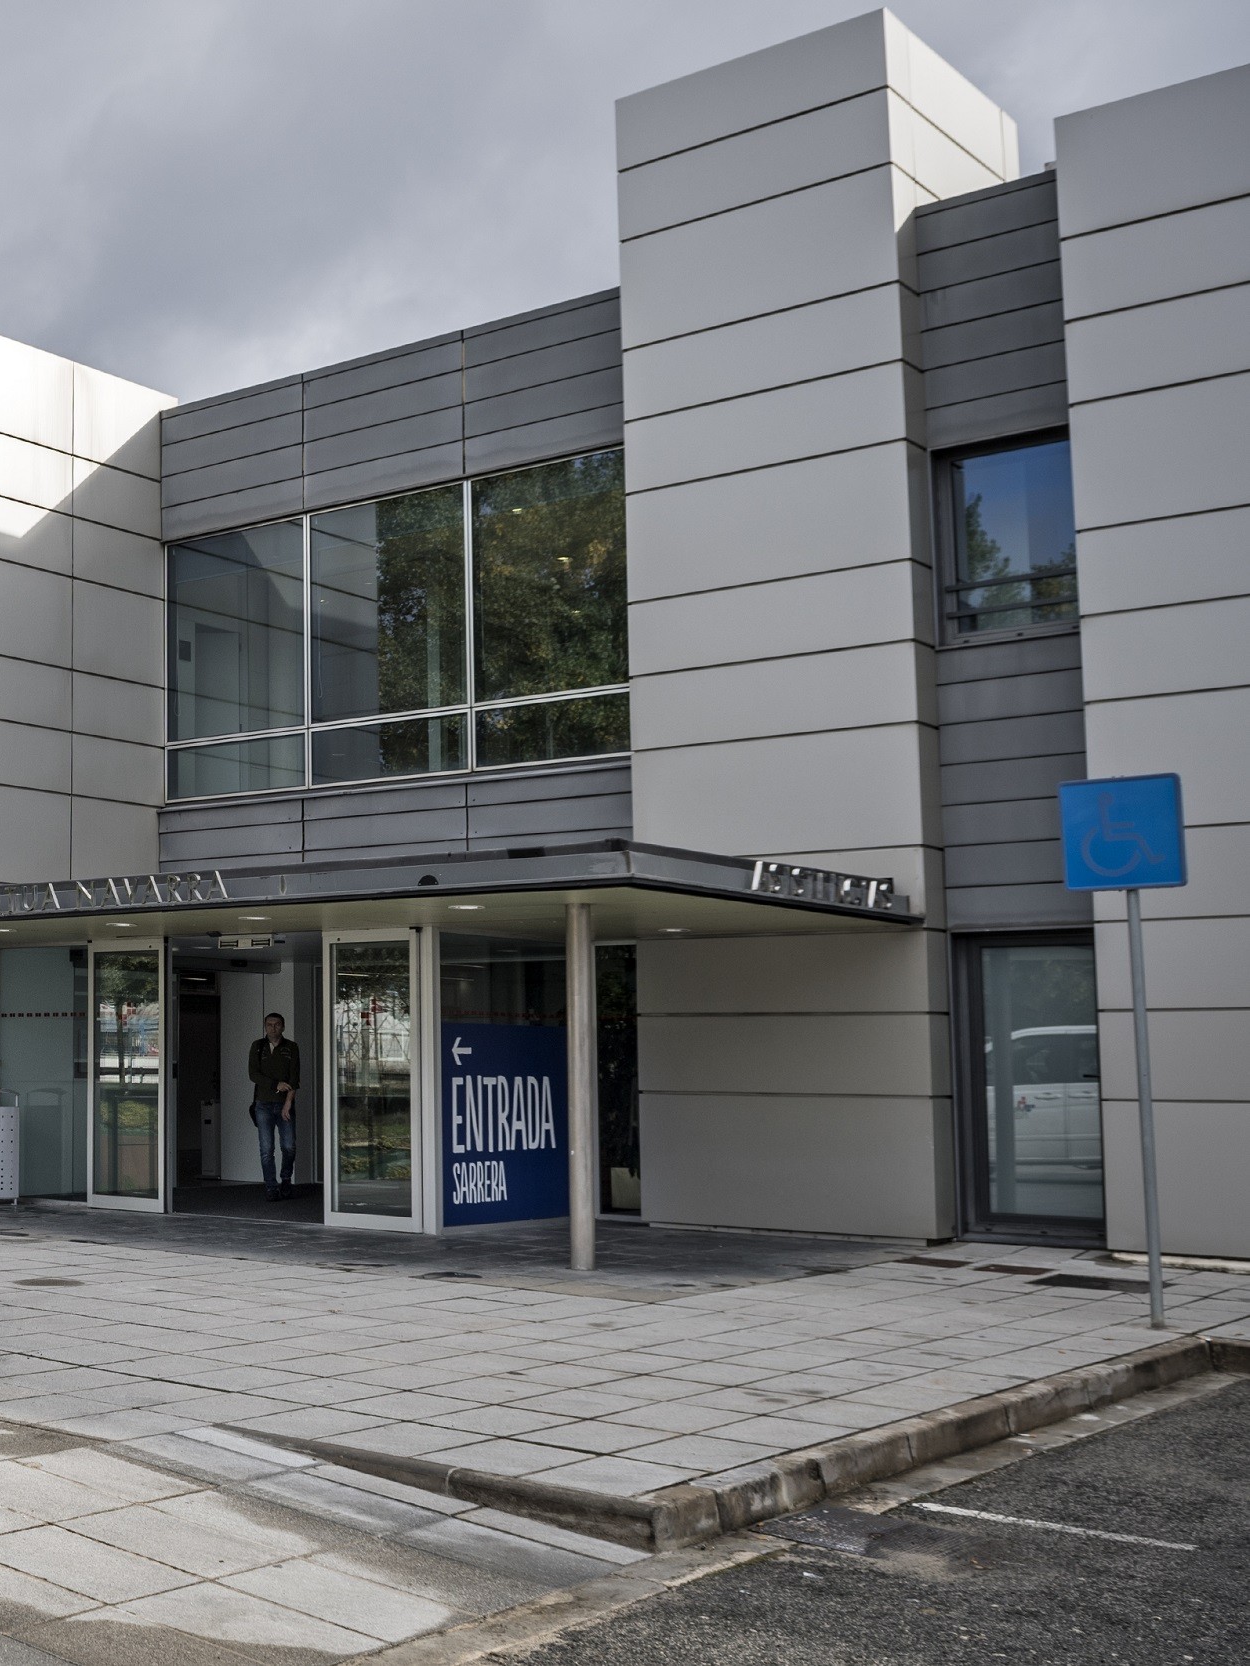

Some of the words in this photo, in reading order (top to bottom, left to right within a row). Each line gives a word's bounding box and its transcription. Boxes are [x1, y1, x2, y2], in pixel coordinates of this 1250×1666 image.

[74, 871, 229, 911] NAVARRA
[452, 1075, 556, 1153] ENTRADA
[453, 1160, 508, 1204] SARRERA
